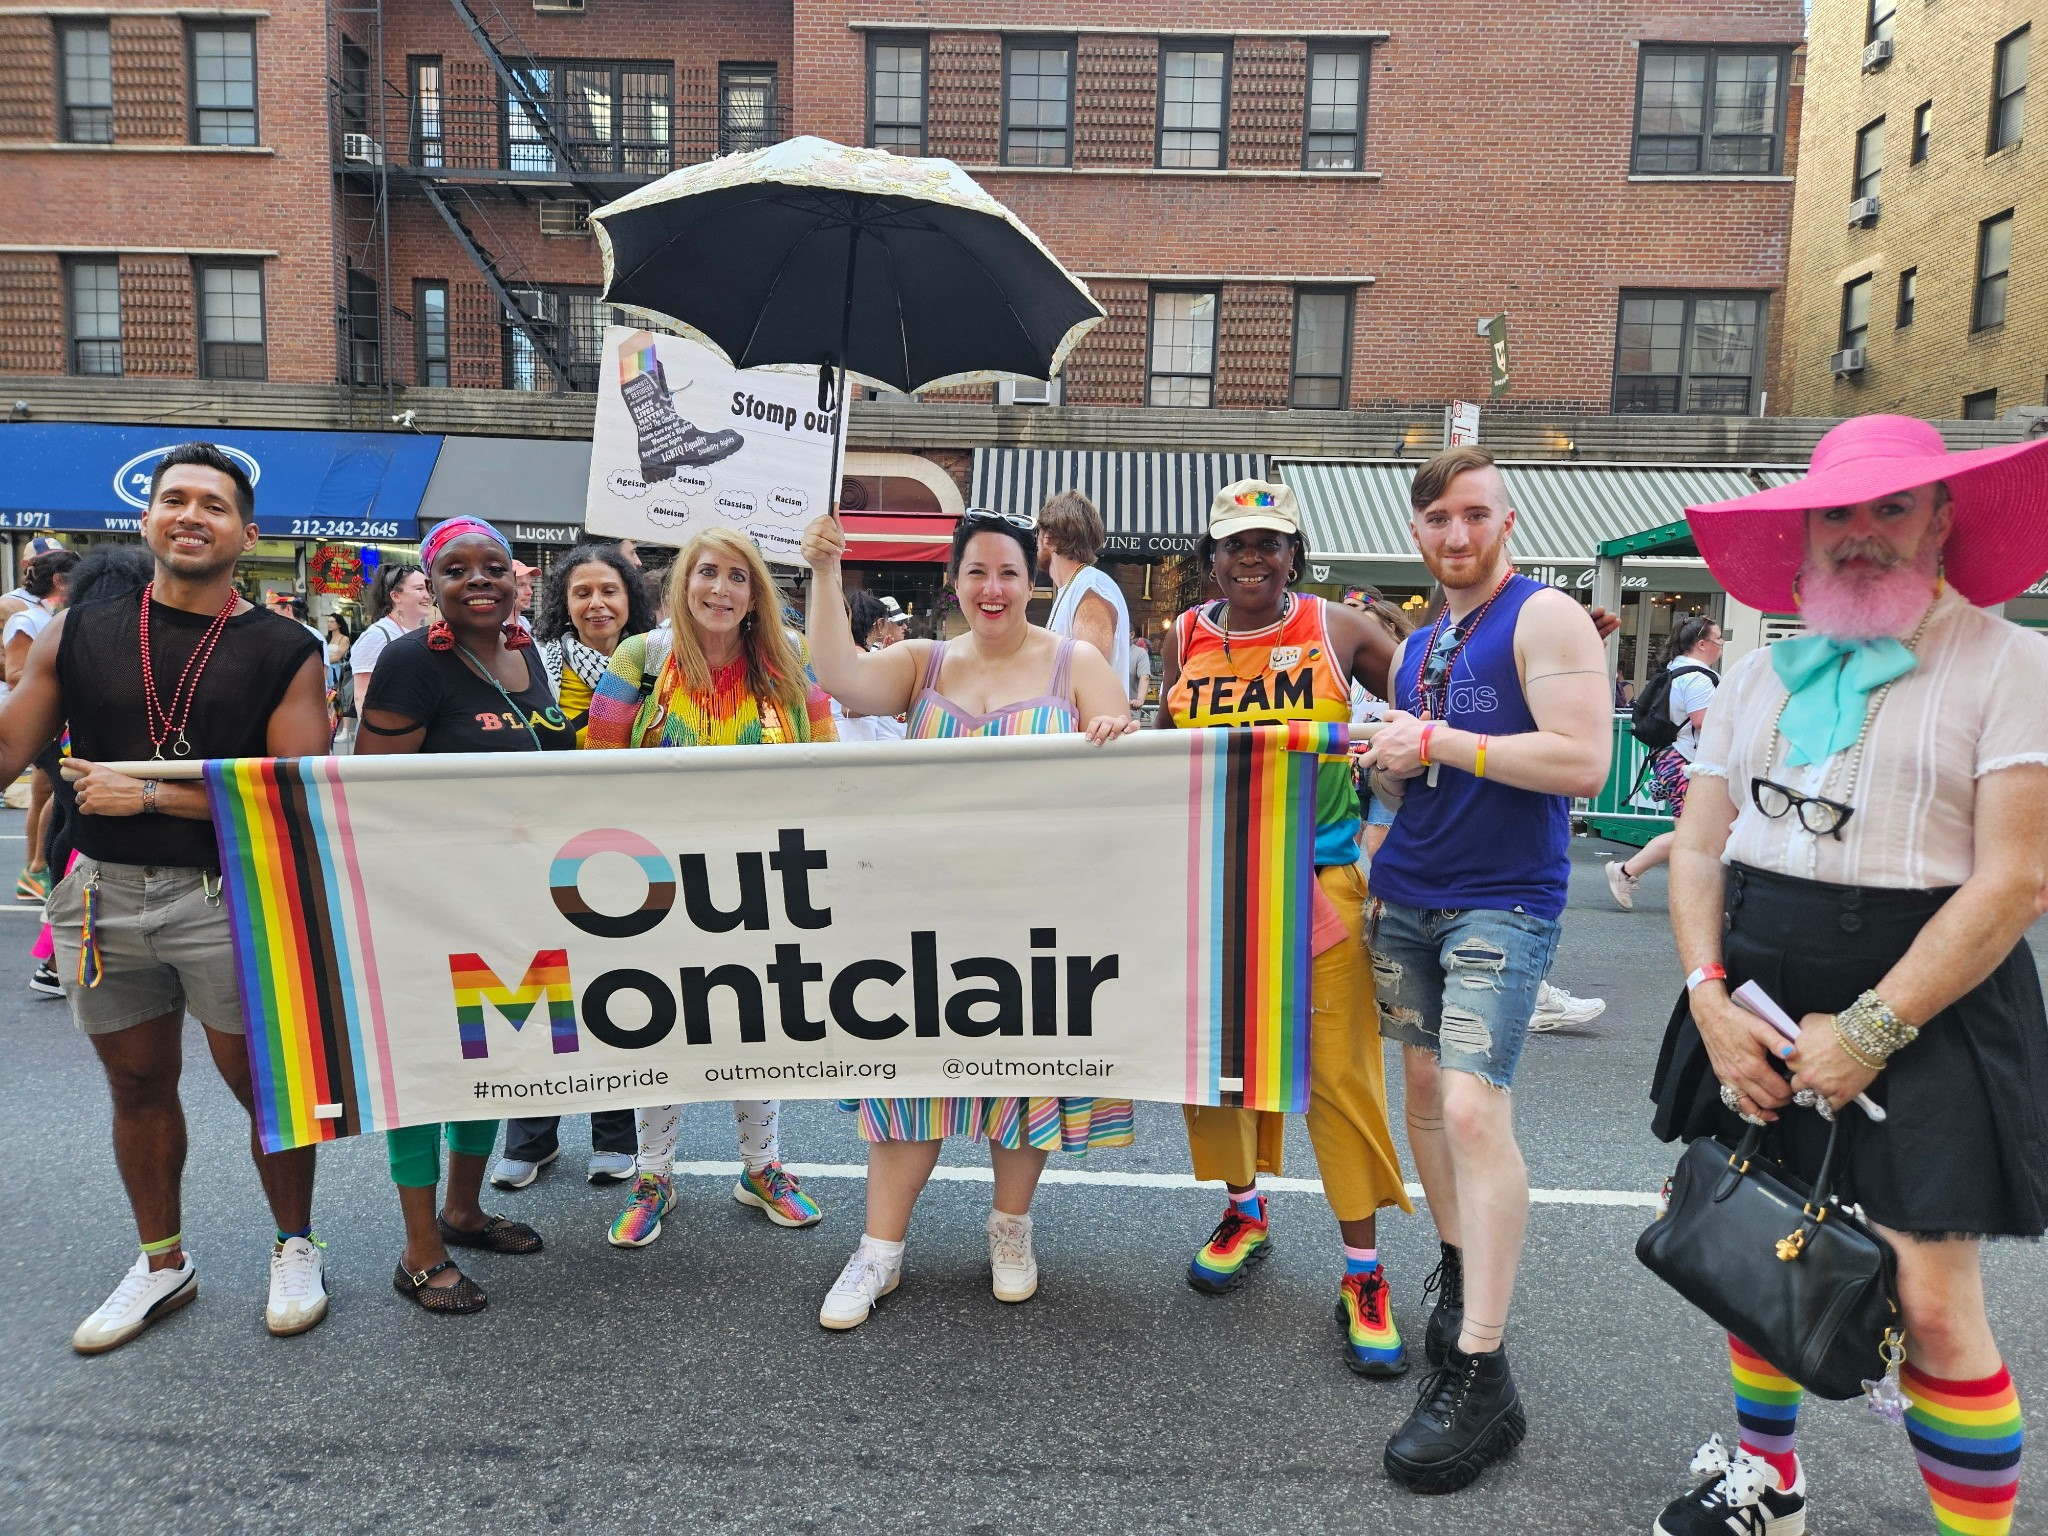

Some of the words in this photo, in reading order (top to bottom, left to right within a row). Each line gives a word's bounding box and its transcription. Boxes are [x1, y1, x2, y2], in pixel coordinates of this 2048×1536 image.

[634, 400, 653, 413] BLACK
[636, 407, 654, 419] LIVES
[731, 391, 797, 431] Stomp
[639, 409, 664, 425] MATTER
[651, 431, 675, 445] Women's
[676, 423, 693, 435] Rights
[669, 436, 682, 447] Rights
[720, 437, 734, 447] Rights
[661, 448, 684, 462] LGBTQ
[685, 436, 707, 452] Equality
[616, 478, 647, 489] Ageism
[678, 476, 706, 486] Sexism
[718, 498, 753, 512] Classism
[775, 494, 802, 507] Racism
[15, 511, 51, 528] 1971
[653, 507, 685, 519] Ableism
[291, 519, 399, 537] 212-242-2645
[515, 524, 565, 541] LUCKY
[1187, 667, 1314, 720] TEAM
[549, 828, 832, 938] Out
[448, 928, 1119, 1059] Montclair
[473, 1068, 669, 1098] #montclairpride
[705, 1061, 896, 1080] outmontclair.org
[943, 1058, 1114, 1079] @outmontclair
